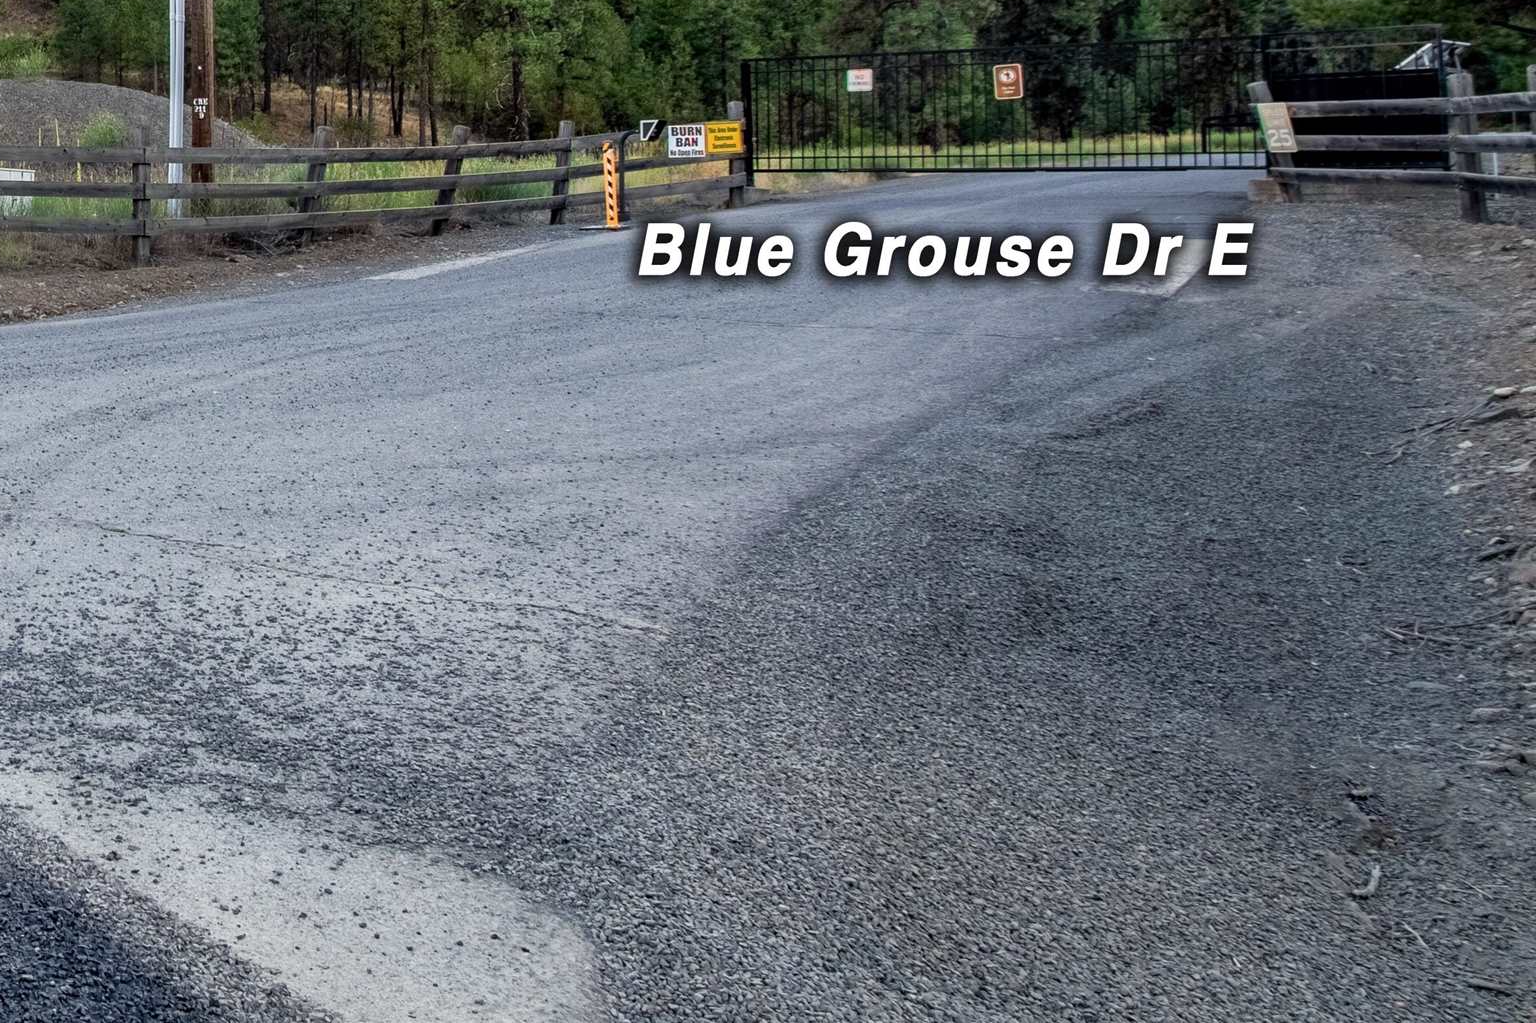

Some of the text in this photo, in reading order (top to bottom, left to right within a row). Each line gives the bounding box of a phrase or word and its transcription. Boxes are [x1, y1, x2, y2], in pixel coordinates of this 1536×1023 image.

[671, 126, 702, 137] BURN
[675, 137, 699, 147] BAN
[1267, 128, 1293, 147] 25
